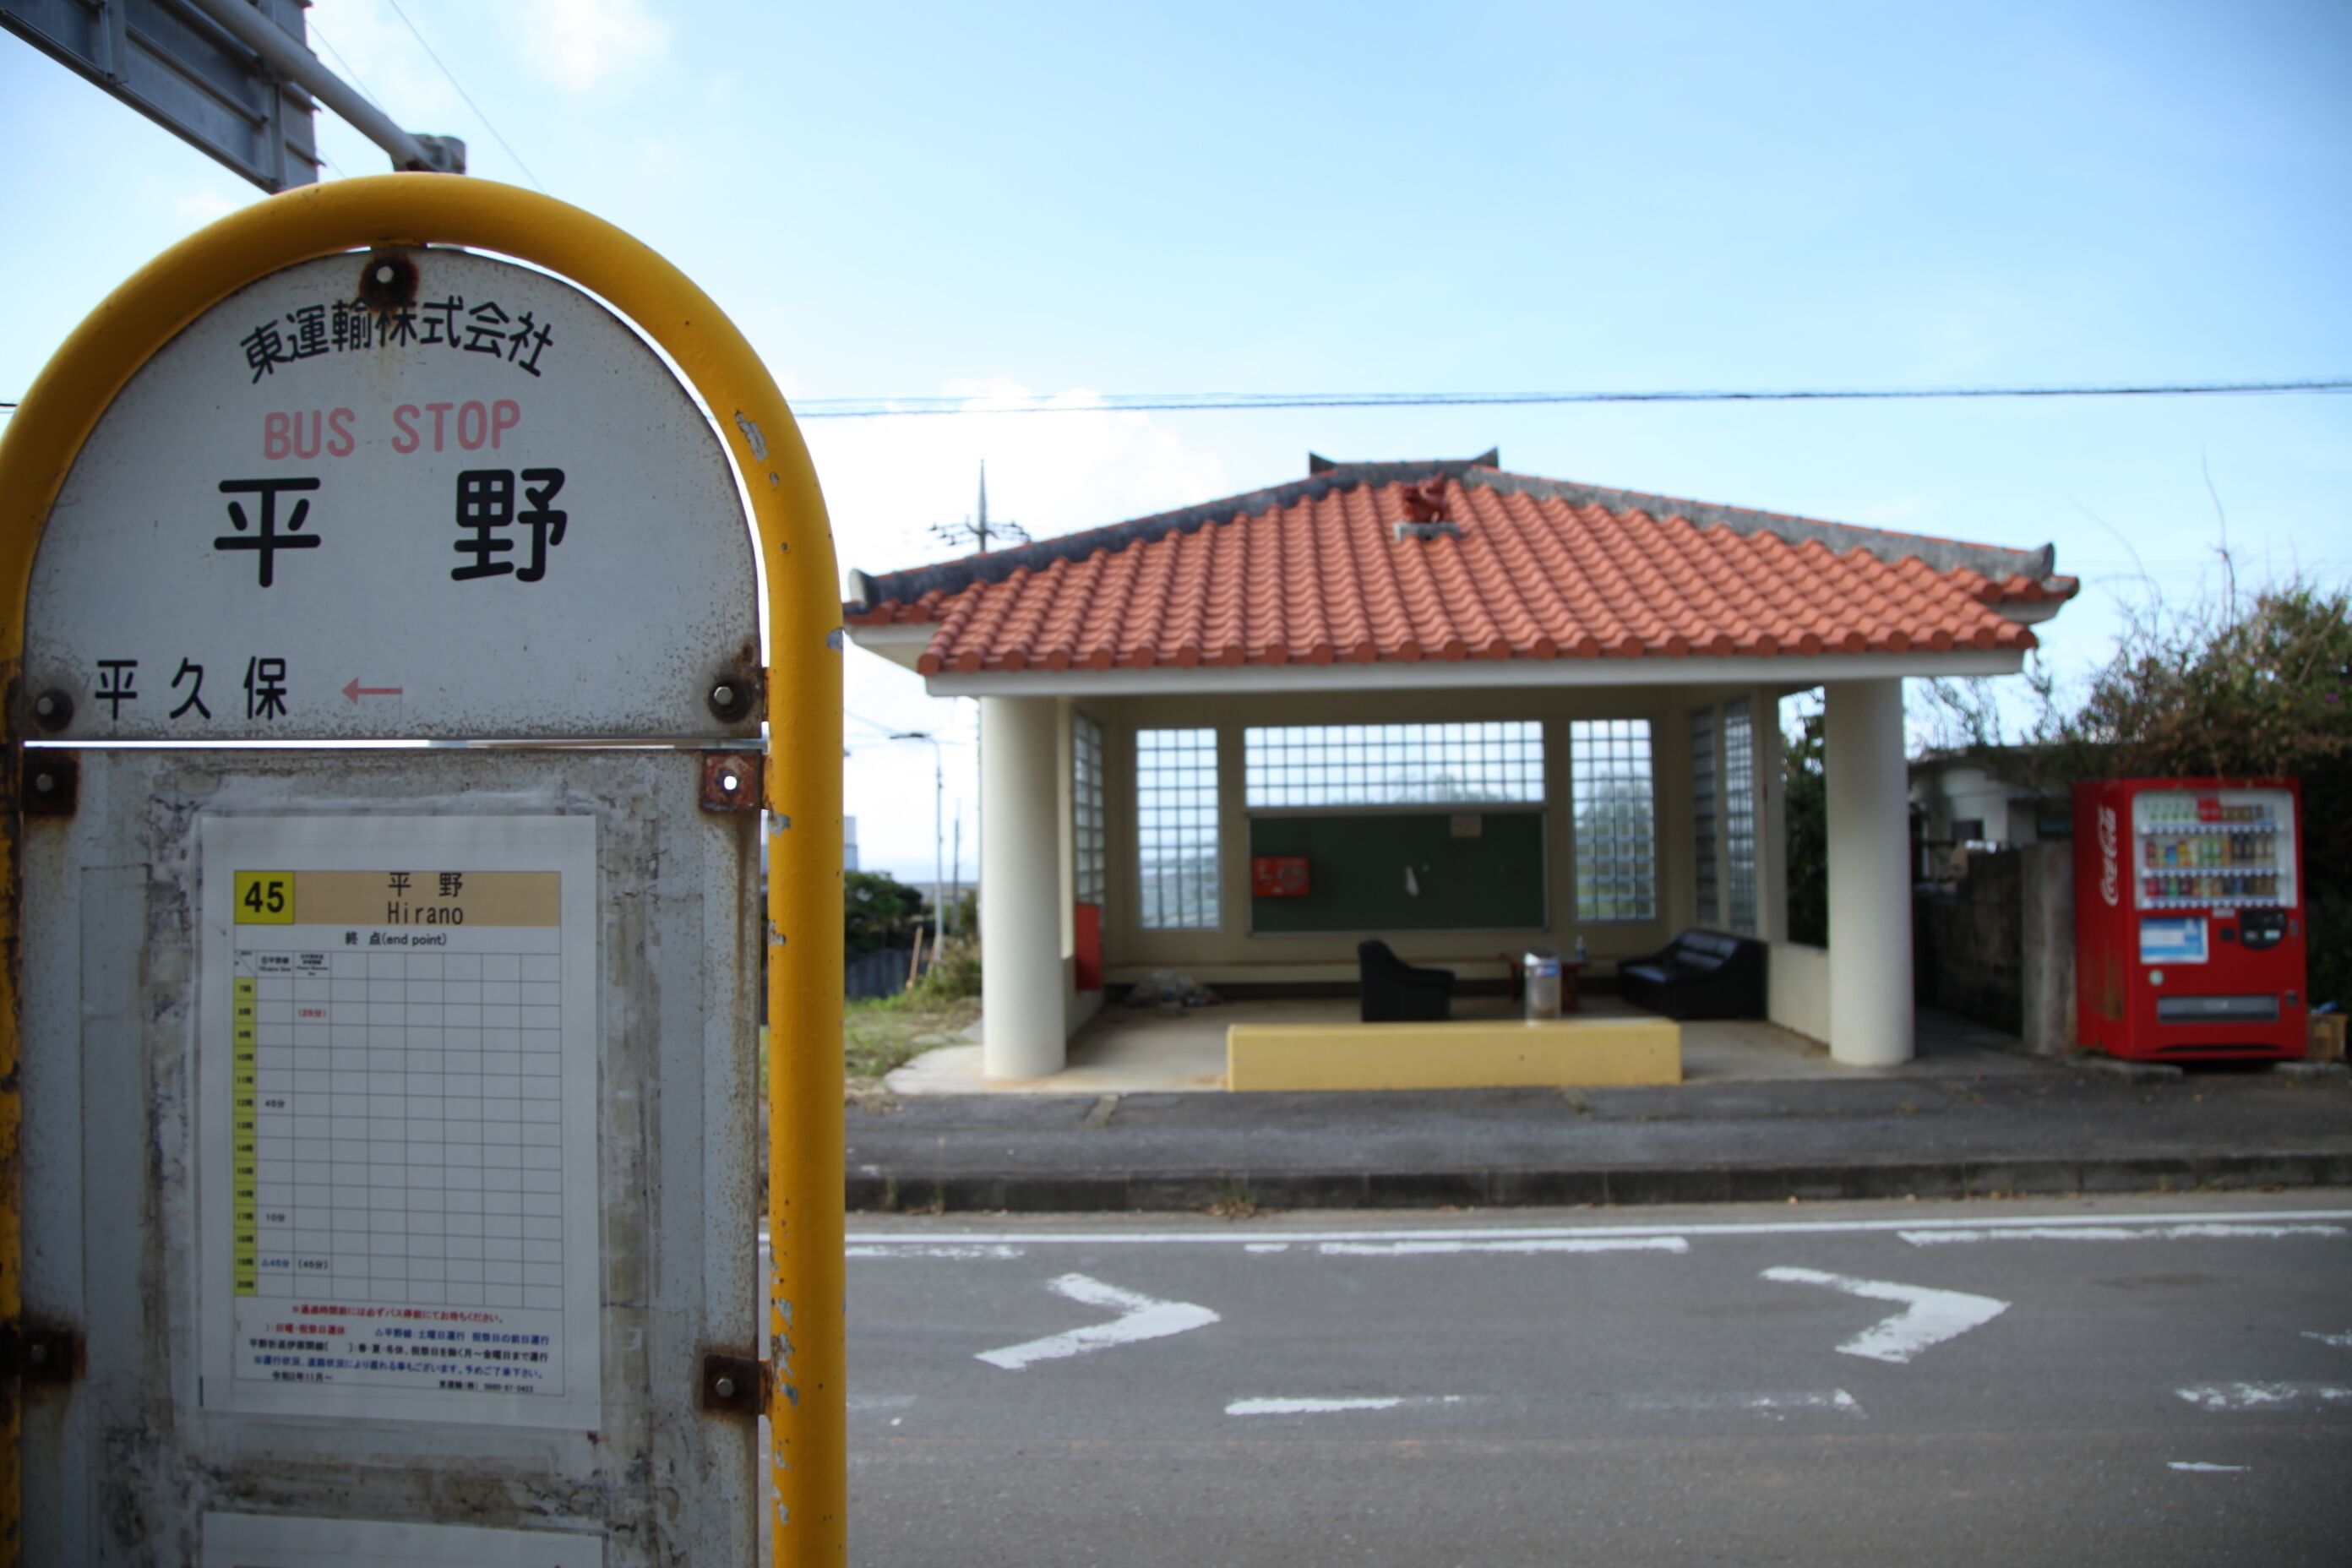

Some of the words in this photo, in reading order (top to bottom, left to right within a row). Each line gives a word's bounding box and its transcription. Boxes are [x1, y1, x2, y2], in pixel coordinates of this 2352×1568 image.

[240, 295, 553, 384] 東運輸株式会社
[264, 407, 356, 460] BUS
[391, 400, 520, 454] STOP
[95, 656, 287, 721] 平久保
[243, 880, 285, 913] 45
[387, 901, 464, 925] Hirano
